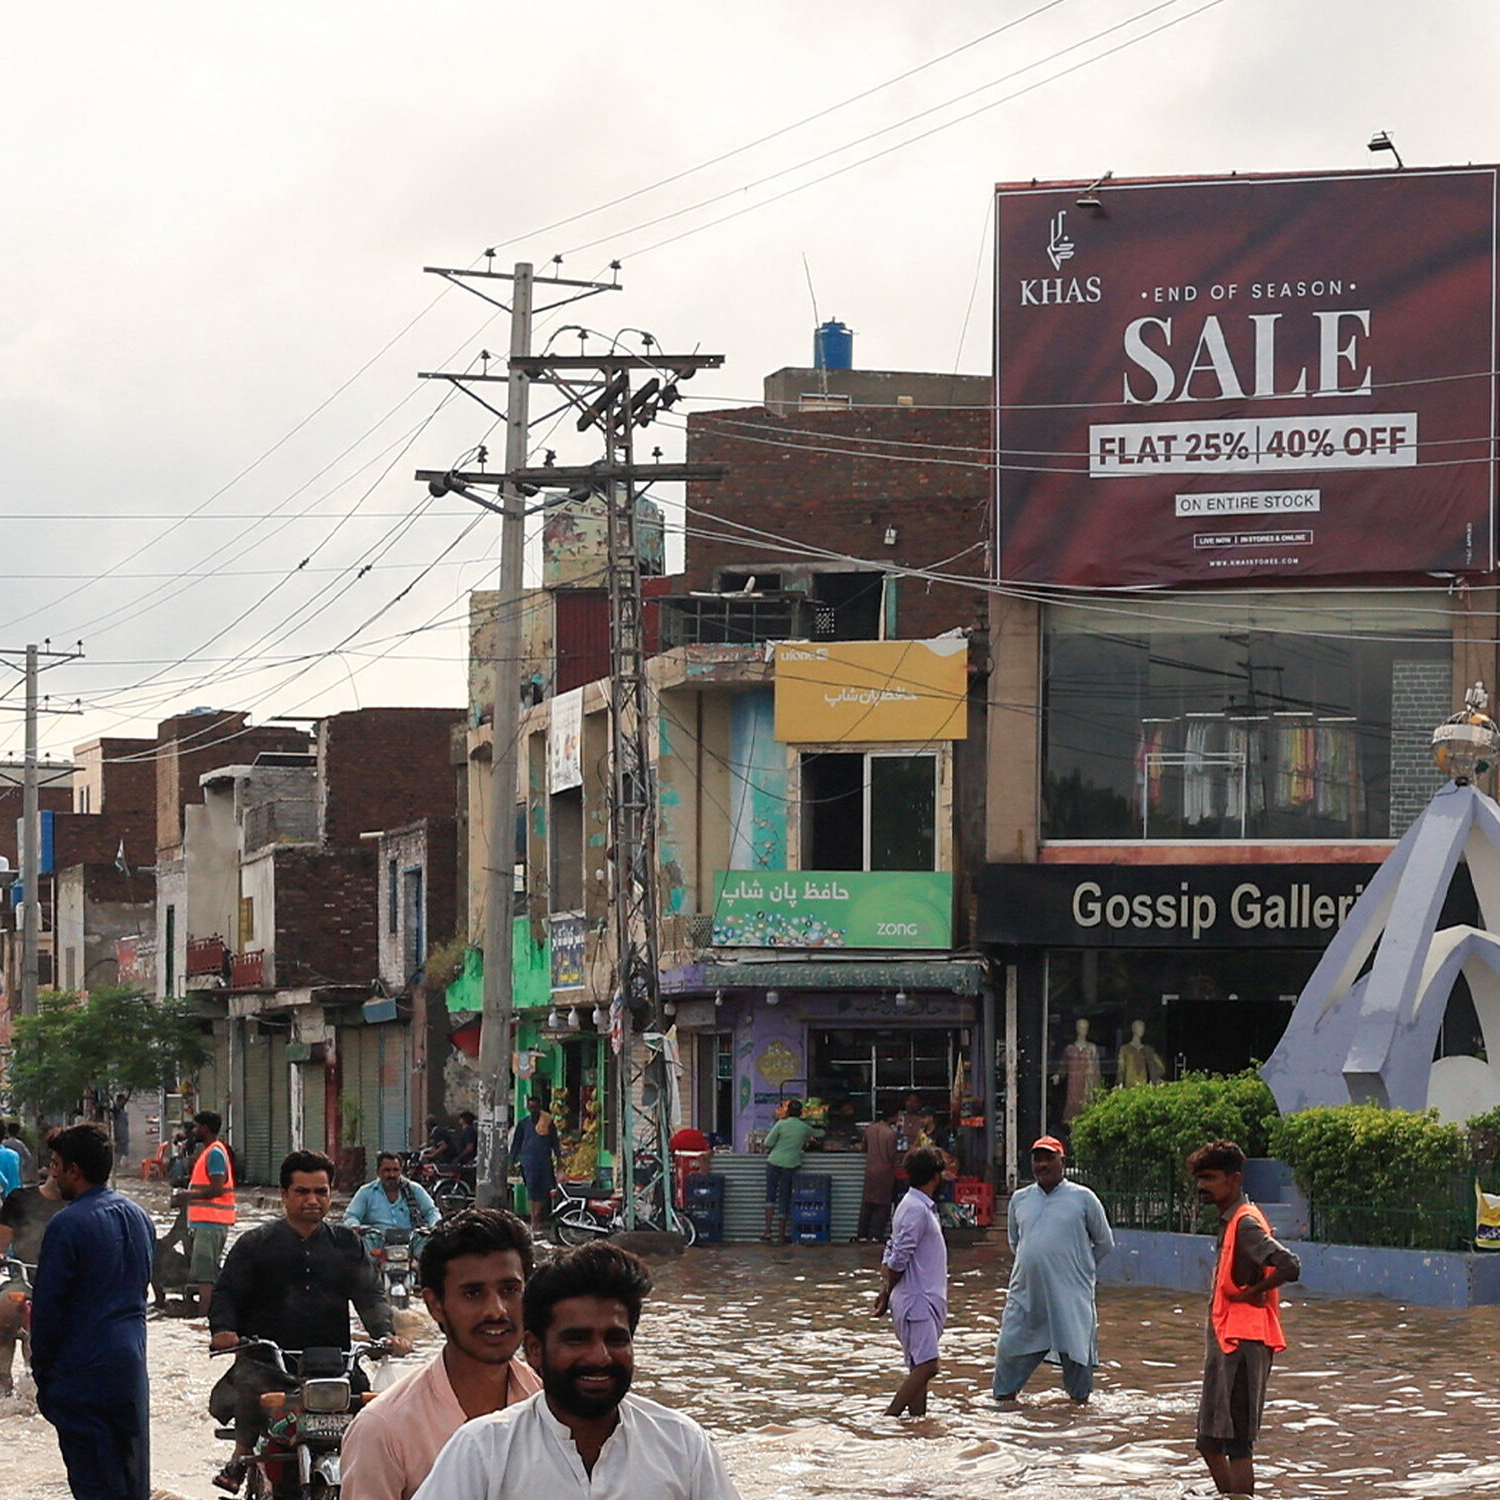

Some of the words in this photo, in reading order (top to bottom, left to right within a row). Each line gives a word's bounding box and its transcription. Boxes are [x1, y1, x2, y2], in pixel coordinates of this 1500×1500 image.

[1020, 276, 1102, 306] KHAS
[1154, 287, 1198, 303] END
[1210, 284, 1238, 300] OF
[1251, 280, 1342, 299] SEASON
[1123, 310, 1372, 405] SALE
[1100, 435, 1178, 465] FLAT
[1185, 431, 1250, 461] 25%
[1266, 428, 1335, 459] 40%
[1342, 426, 1407, 456] OFF
[1180, 498, 1201, 511] ON
[1207, 496, 1259, 511] ENTIRE
[1264, 494, 1314, 508] STOCK
[1199, 537, 1215, 545] LIVE
[722, 879, 764, 907] شاپ
[769, 882, 797, 908] پان
[802, 881, 850, 900] حافظ
[1072, 881, 1217, 939] Gossip
